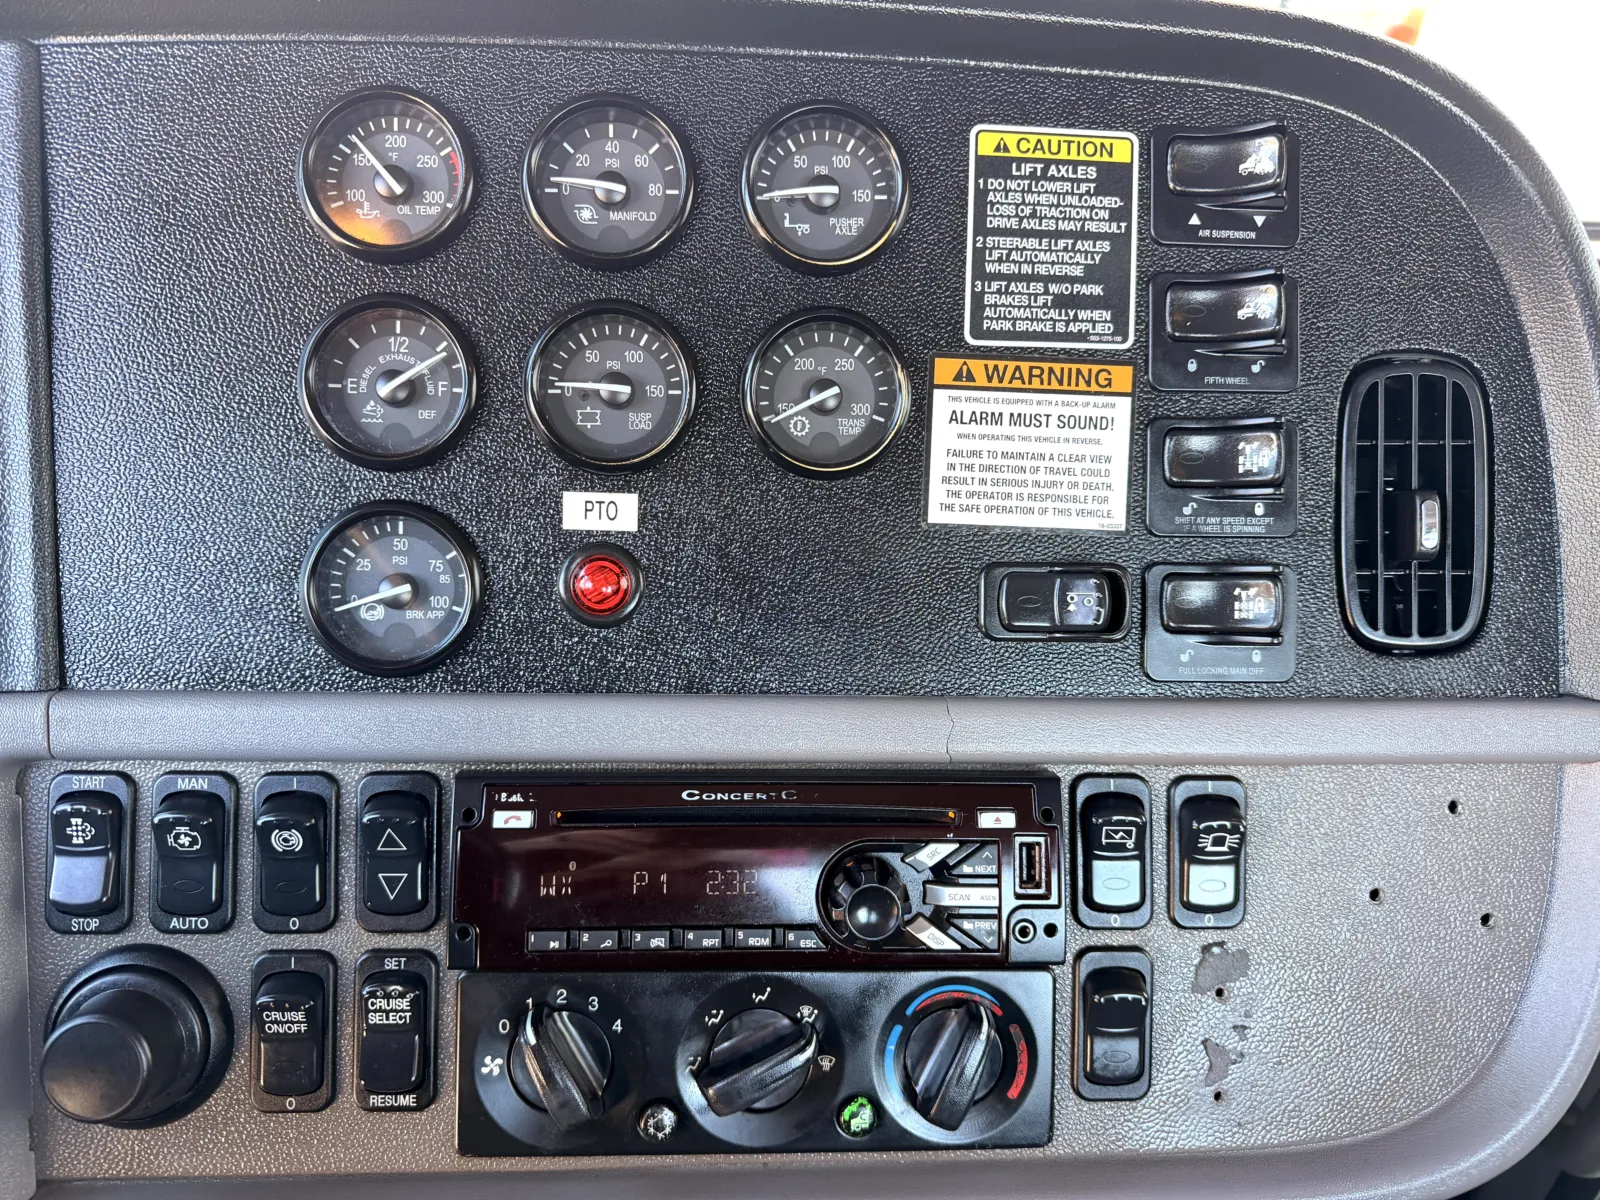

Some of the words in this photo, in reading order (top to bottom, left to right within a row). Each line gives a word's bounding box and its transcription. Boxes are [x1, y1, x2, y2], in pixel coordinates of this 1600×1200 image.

[385, 135, 406, 148] 200
[605, 141, 619, 153] 40
[1016, 138, 1113, 158] CAUTION
[417, 155, 438, 168] 250
[576, 154, 590, 166] 20
[605, 159, 619, 168] PSI
[635, 155, 649, 167] 60
[794, 156, 807, 168] 50
[832, 156, 850, 168] 100
[814, 166, 828, 174] PSI
[1012, 163, 1044, 176] LIFT
[1048, 165, 1097, 178] AXLES
[649, 184, 662, 196] 80
[978, 179, 983, 189] 1
[988, 179, 1004, 189] DO
[1007, 180, 1029, 191] NOT
[1032, 181, 1071, 192] LOWER
[1074, 183, 1096, 194] LIFT
[346, 189, 365, 201] 100
[423, 191, 444, 203] 300
[852, 190, 871, 202] 150
[987, 192, 1022, 203] AXLES
[1024, 194, 1058, 205] WHEN
[1060, 195, 1124, 208] UNLOADED-
[398, 205, 412, 215] OIL
[415, 206, 440, 215] TEMP
[987, 205, 1016, 216] LOSS
[1018, 206, 1032, 216] OF
[1035, 207, 1089, 219] TRACTION
[1092, 209, 1109, 220] ON
[610, 212, 656, 222] MANIFOLD
[830, 218, 864, 226] PUSHER
[835, 227, 857, 235] AXLE
[987, 218, 1019, 229] DRIVE
[1021, 219, 1055, 230] AXLES
[1058, 220, 1082, 231] MAY
[1085, 222, 1127, 233] RESULT
[1212, 230, 1256, 239] SUSPENSION
[976, 237, 983, 247] 2
[986, 237, 1049, 249] STEERABLE
[1051, 239, 1073, 250] LIFT
[1075, 241, 1110, 252] AXLES
[986, 250, 1008, 261] LIFT
[1010, 251, 1102, 264] AUTOMATICALLY
[985, 263, 1019, 274] WHEN
[1021, 264, 1032, 274] IN
[1035, 264, 1084, 276] REVERSE
[975, 281, 981, 291] 3
[985, 281, 1007, 292] LIFT
[1008, 283, 1044, 293] AXLES
[1048, 283, 1071, 294] W/O
[1073, 284, 1103, 295] PARK
[984, 294, 1028, 305] BRAKES
[1031, 295, 1053, 306] LIFT
[983, 307, 1075, 319] AUTOMATICALLY
[1078, 310, 1111, 321] WHEN
[983, 320, 1013, 331] PARK
[1016, 321, 1053, 332] BRAKE
[1055, 322, 1066, 332] IS
[1067, 323, 1114, 334] APPLIED
[389, 337, 409, 352] 1/2
[586, 351, 599, 362] 50
[624, 351, 643, 363] 100
[607, 361, 620, 369] PSI
[795, 358, 814, 370] 200
[835, 359, 854, 370] 250
[359, 365, 376, 392] DIESEL
[984, 364, 1112, 389] WARNING
[348, 379, 358, 393] E
[438, 382, 448, 396] F
[645, 385, 664, 397] 150
[418, 411, 437, 419] DEF
[851, 404, 870, 415] 300
[629, 413, 652, 421] SUSP
[838, 419, 865, 427] TRANS
[949, 410, 1003, 426] ALARM
[1009, 413, 1052, 428] MUST
[1057, 414, 1115, 431] SOUND!
[629, 421, 652, 429] LOAD
[839, 427, 861, 435] TEMP
[946, 449, 984, 459] FAILURE
[987, 451, 998, 459] TO
[1000, 451, 1046, 461] MAINTAIN
[1049, 453, 1055, 462] A
[1058, 453, 1086, 463] CLEAR
[1089, 455, 1112, 464] VIEW
[947, 463, 956, 471] IN
[959, 463, 976, 472] THE
[979, 464, 1027, 474] DIRECTION
[1029, 466, 1041, 474] OF
[1044, 466, 1078, 476] TRAVEL
[1081, 468, 1110, 477] COULD
[941, 476, 975, 486] RESULT
[978, 477, 987, 486] IN
[990, 478, 1028, 488] SERIOUS
[1031, 480, 1064, 489] INJURY
[1067, 481, 1080, 490] OR
[1082, 482, 1114, 492] DEATH.
[946, 490, 962, 499] THE
[965, 491, 1013, 501] OPERATOR
[1016, 493, 1025, 501] IS
[1027, 493, 1088, 504] RESPONSIBLE
[1092, 495, 1109, 505] FOR
[585, 501, 618, 521] PTO
[939, 503, 956, 512] THE
[958, 504, 981, 513] SAFE
[984, 505, 1034, 515] OPERATION
[1038, 507, 1049, 515] OF
[1052, 507, 1073, 517] THIS
[1075, 508, 1114, 518] VEHICLE.
[393, 539, 408, 550] 50
[356, 559, 371, 571] 25
[392, 556, 408, 565] PSI
[429, 560, 443, 572] 75
[439, 575, 450, 583] 85
[429, 596, 449, 608] 100
[406, 611, 424, 619] BRK
[427, 611, 444, 619] APP
[72, 777, 106, 788] START
[178, 778, 208, 789] MAN
[707, 870, 758, 894] 2:32
[948, 893, 970, 901] SCAN
[71, 919, 99, 931] STOP
[170, 918, 208, 929] AUTO
[975, 922, 997, 930] PREV
[384, 958, 406, 969] SET
[557, 989, 567, 1003] 2
[368, 999, 411, 1010] CRUISE
[526, 998, 532, 1010] 1
[589, 996, 598, 1011] 3
[263, 1012, 306, 1021] CRUISE
[368, 1012, 412, 1024] SELECT
[265, 1024, 308, 1033] ON/OFF
[499, 1019, 510, 1034] 0
[612, 1019, 622, 1033] 4
[370, 1095, 417, 1106] RESUME
